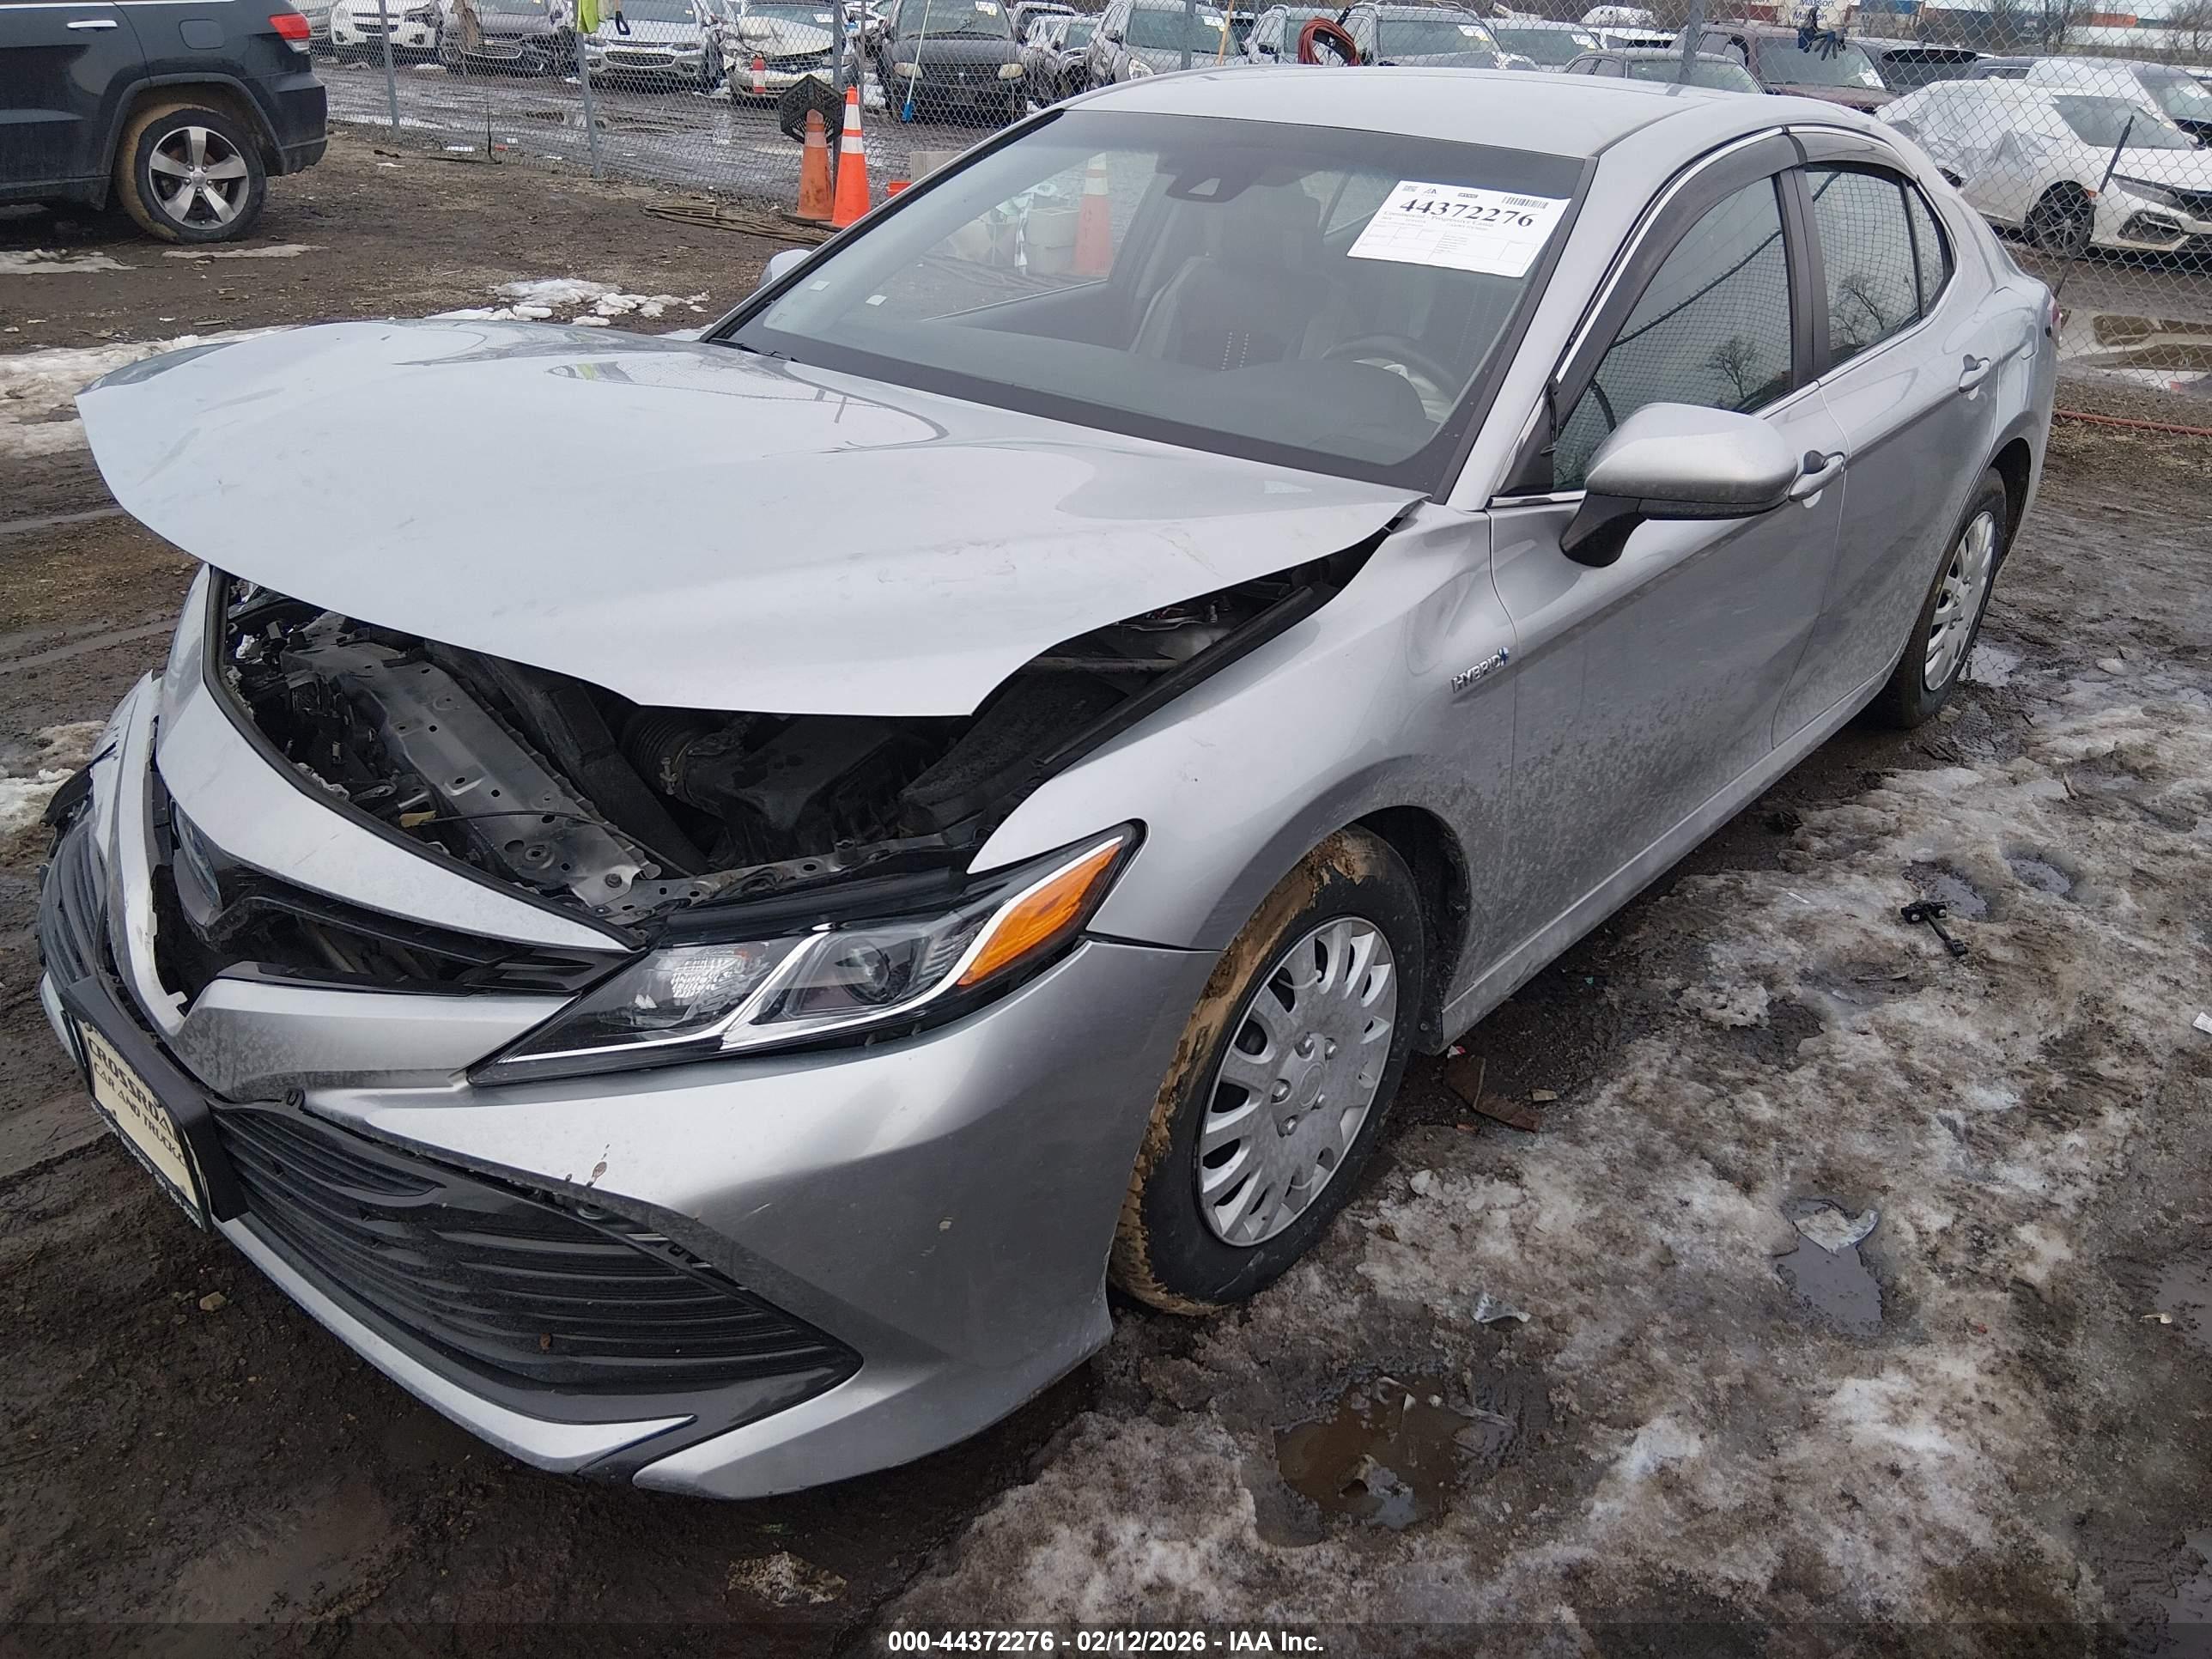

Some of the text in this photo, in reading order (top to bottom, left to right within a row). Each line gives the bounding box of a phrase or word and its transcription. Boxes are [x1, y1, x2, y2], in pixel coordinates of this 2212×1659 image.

[1793, 10, 1827, 21] Maon
[1399, 198, 1540, 228] 44372276
[1450, 654, 1502, 693] HYBRID
[88, 1037, 179, 1143] CROSSROA
[94, 1062, 115, 1091] CAR
[118, 1090, 141, 1117] AND
